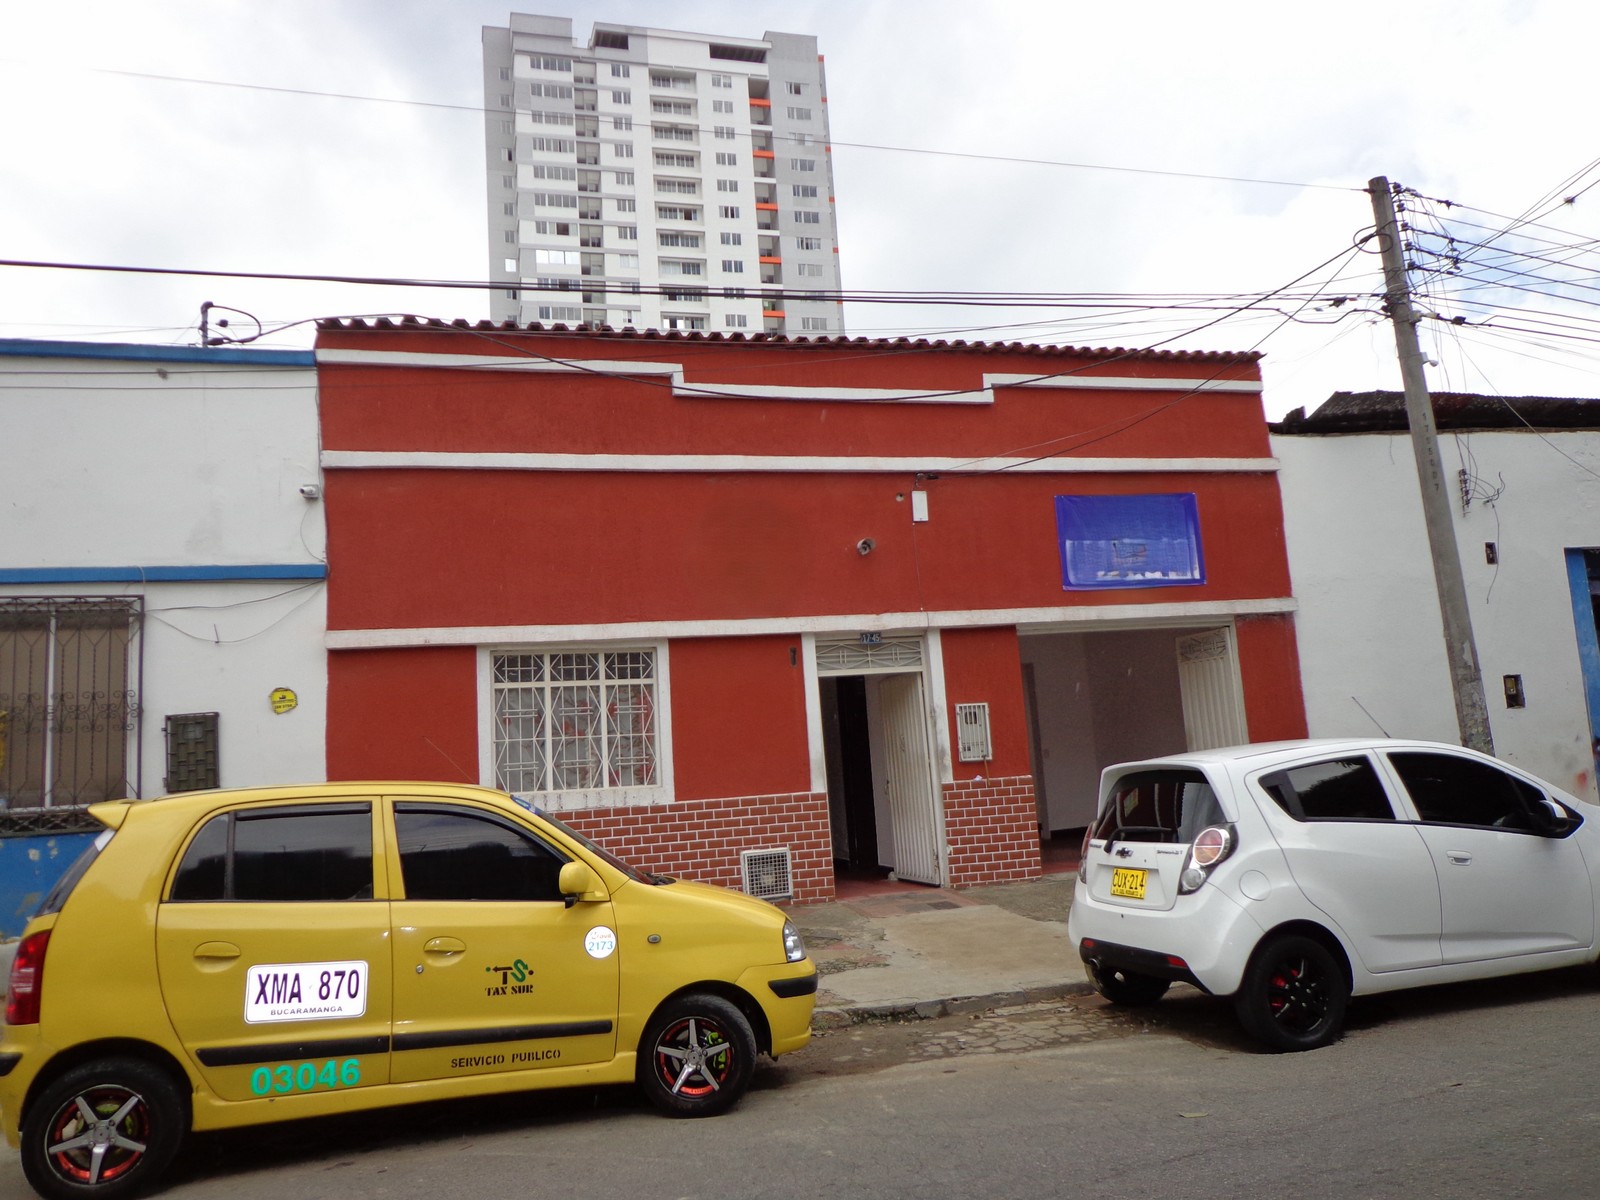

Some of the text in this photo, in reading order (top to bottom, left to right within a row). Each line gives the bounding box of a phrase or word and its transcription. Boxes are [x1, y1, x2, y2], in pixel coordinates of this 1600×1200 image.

[588, 940, 614, 952] 2173
[254, 969, 360, 1005] XMA 870
[485, 986, 508, 997] TAX
[270, 1005, 343, 1016] BUCARAMANGA
[450, 1049, 561, 1069] SERVICIO PUBLICO
[250, 1057, 361, 1096] 03046
